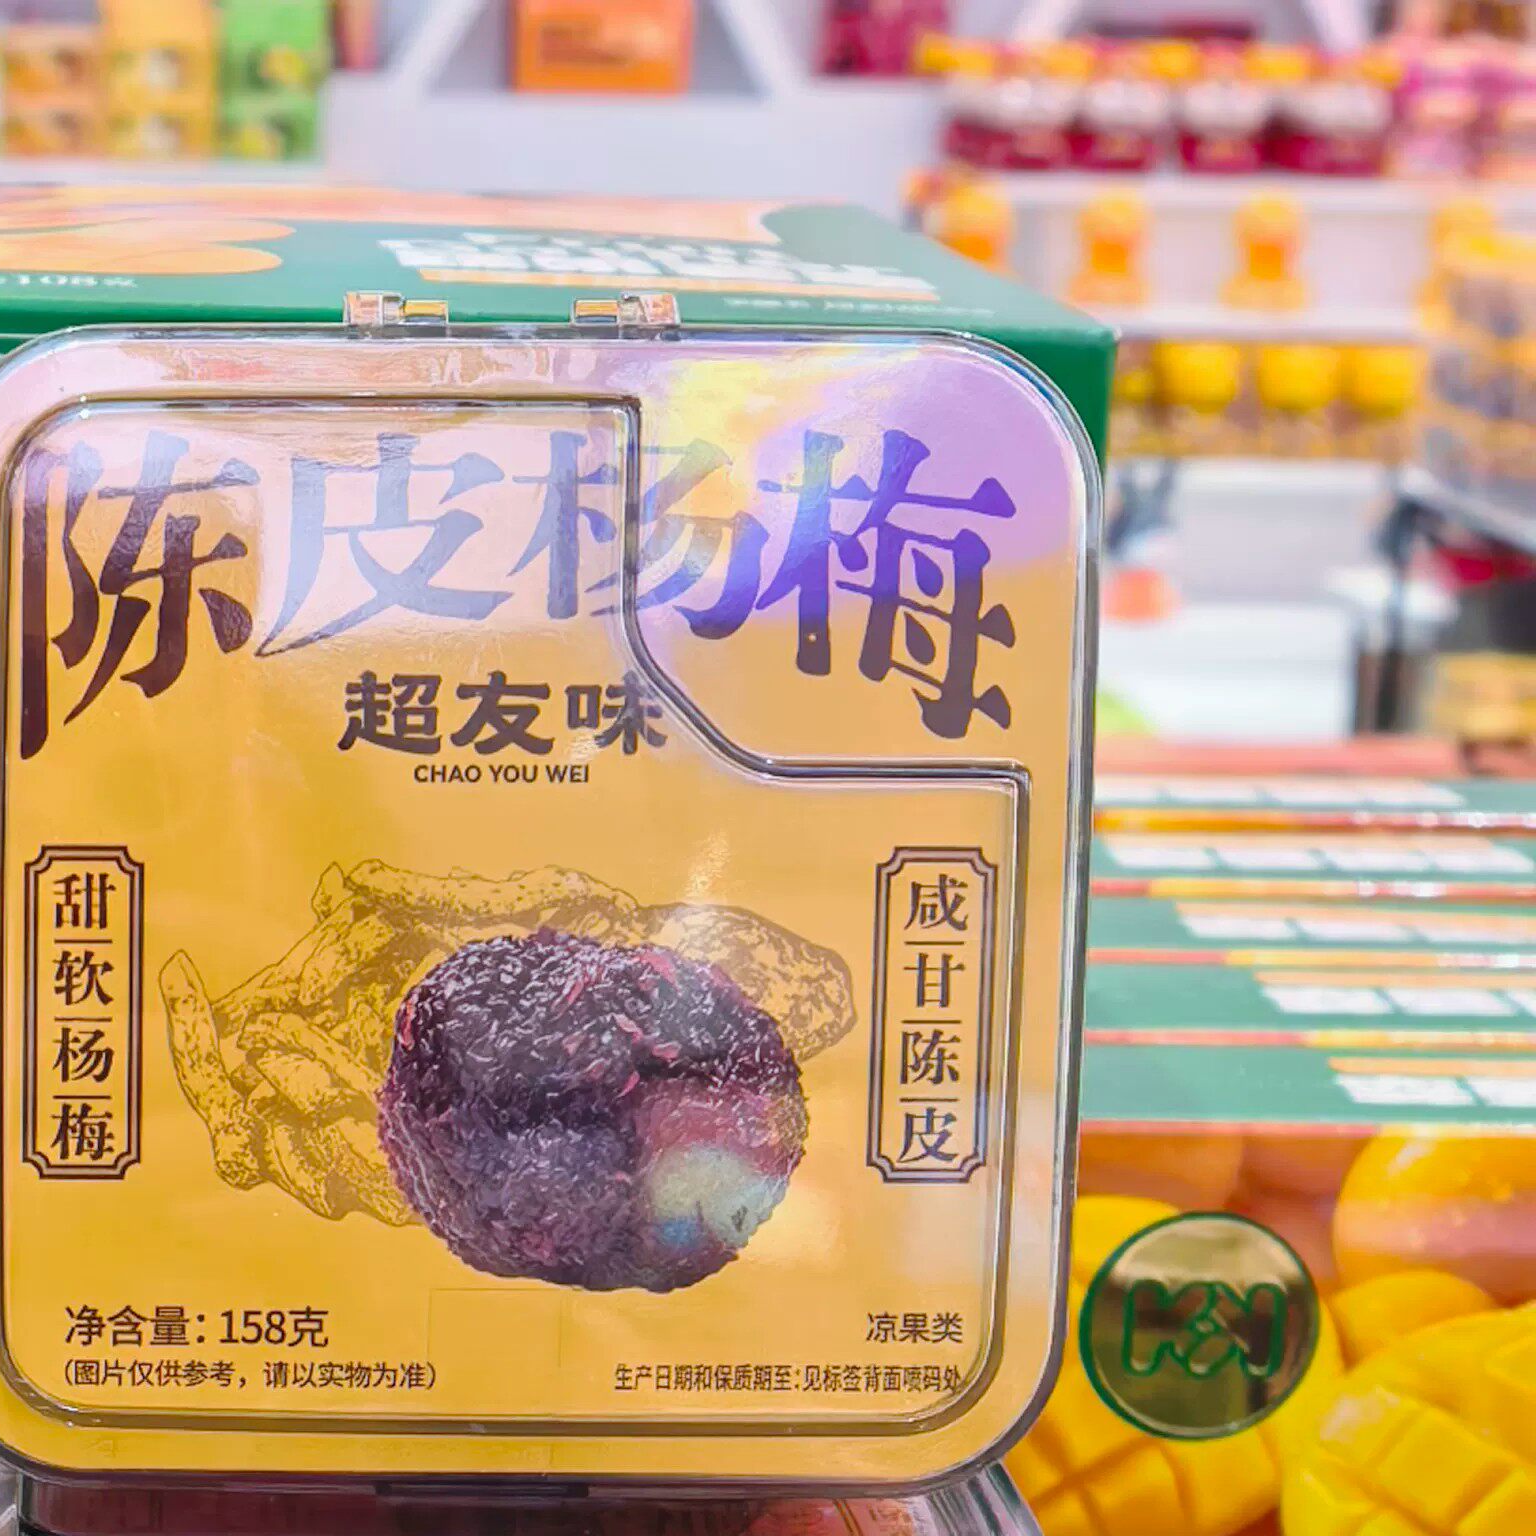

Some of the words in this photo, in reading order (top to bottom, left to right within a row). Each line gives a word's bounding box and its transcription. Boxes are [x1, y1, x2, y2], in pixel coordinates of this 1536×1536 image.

[19, 430, 1016, 761] 陈皮杨梅
[337, 670, 668, 756] 超友味
[414, 765, 481, 784] CHAO
[488, 765, 539, 784] YOU
[545, 765, 590, 784] WEI
[51, 871, 116, 1161] 甜软杨梅
[899, 873, 969, 1164] 咸甘陈皮
[64, 1305, 330, 1348] 净含量：158克
[865, 1311, 964, 1344] 凉果类
